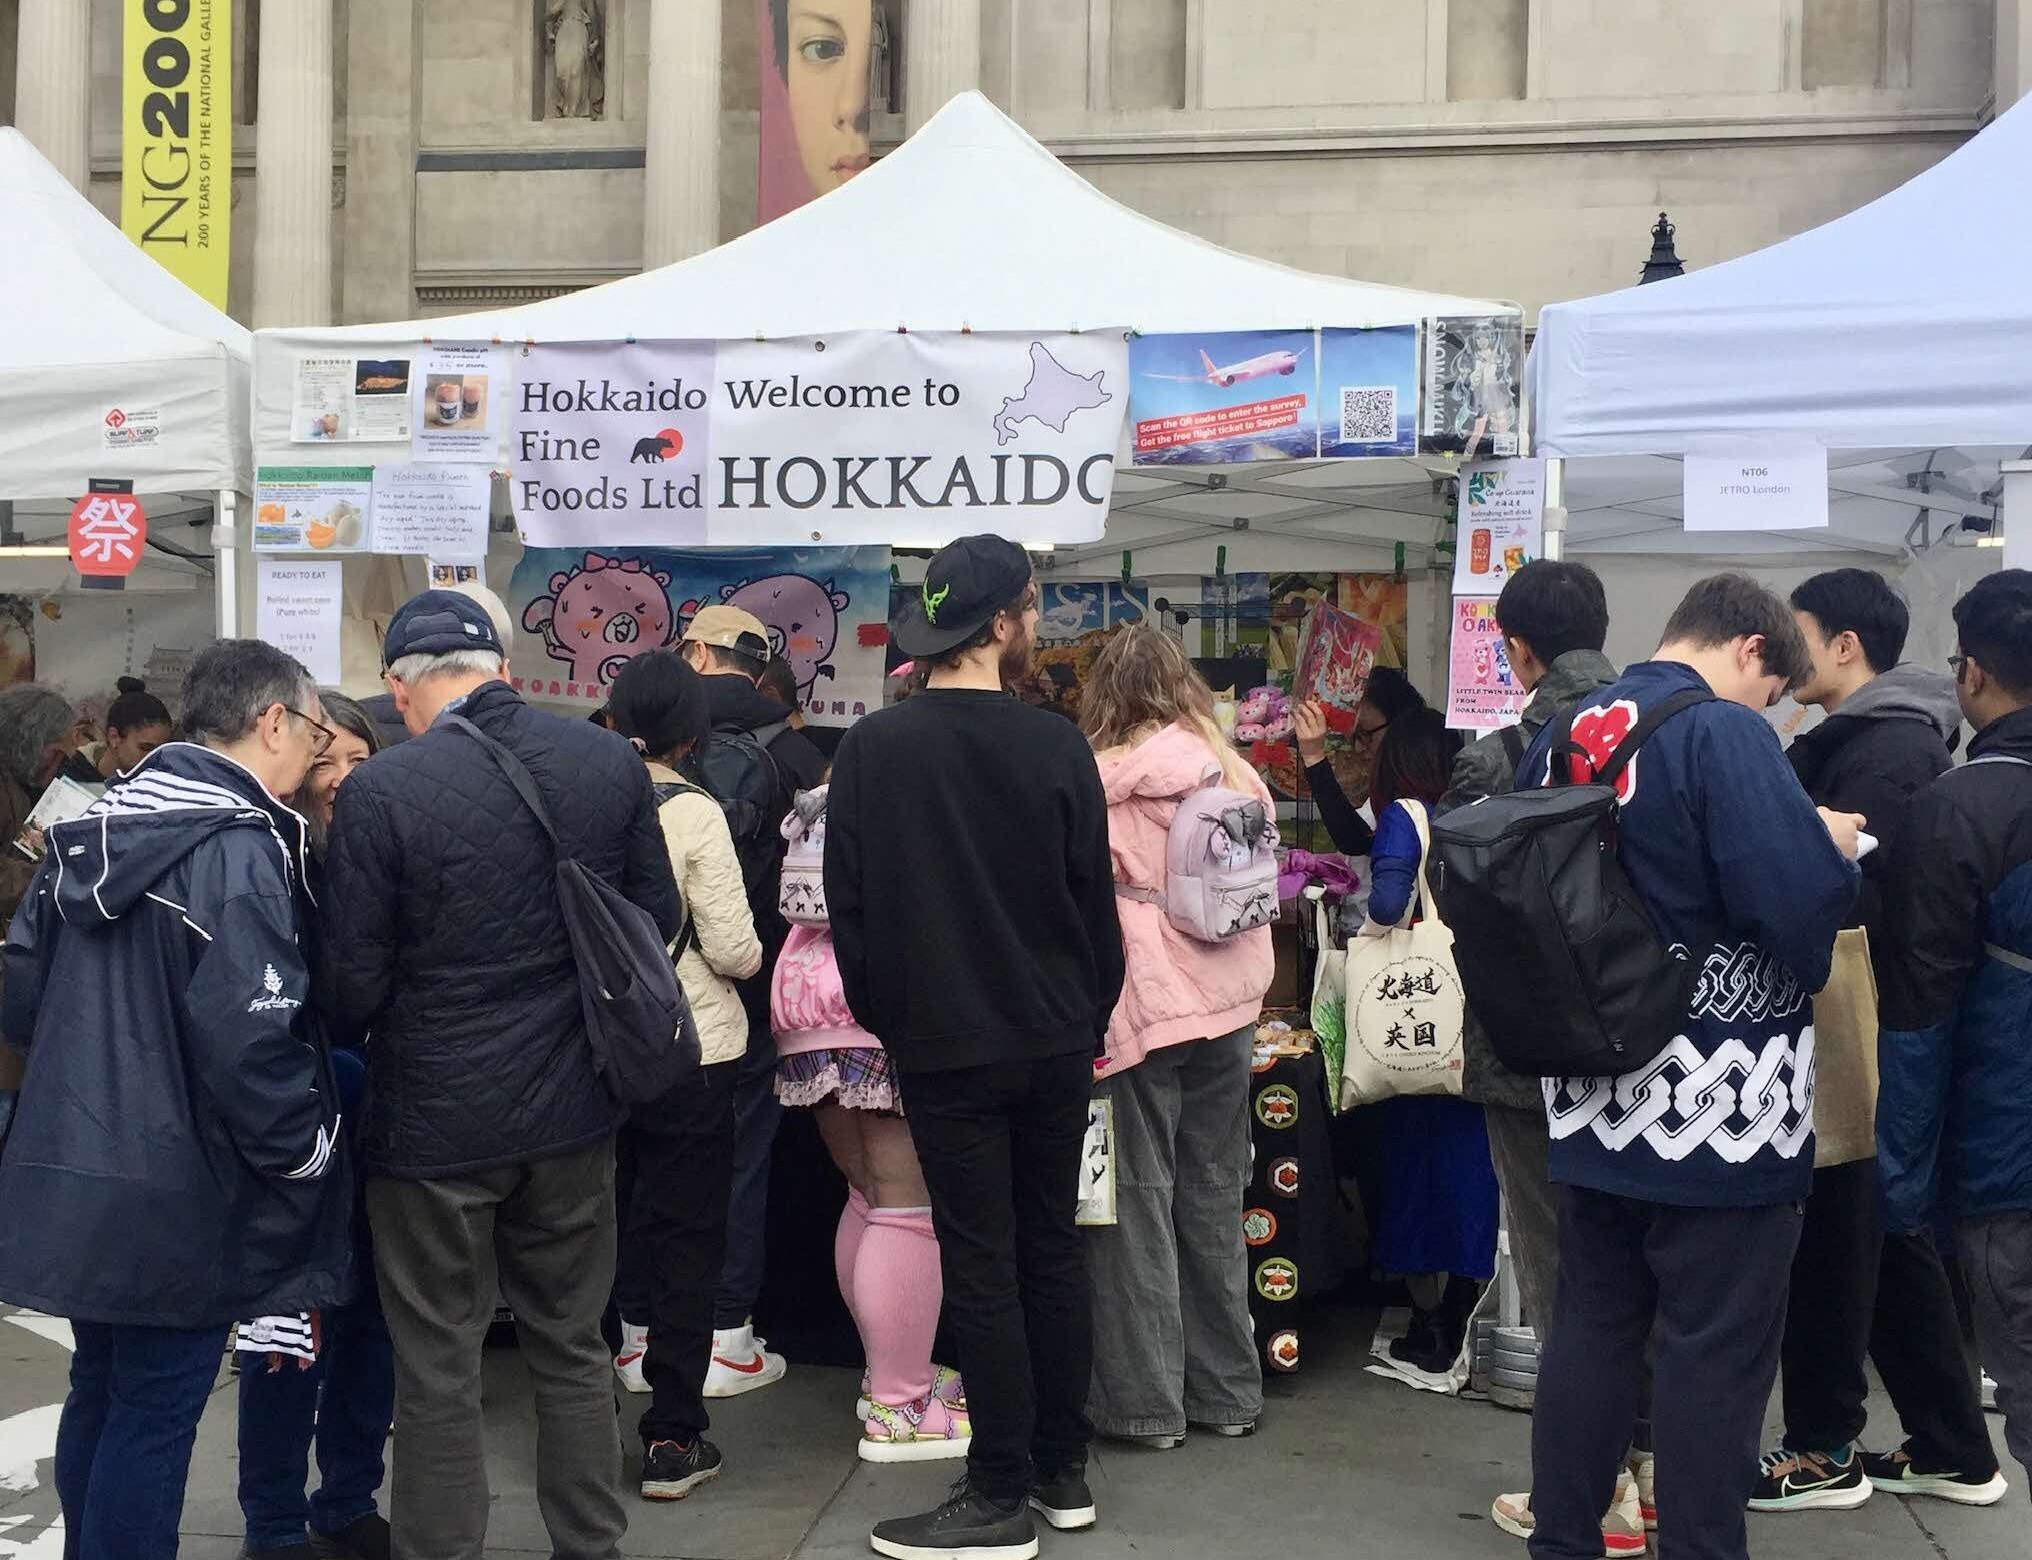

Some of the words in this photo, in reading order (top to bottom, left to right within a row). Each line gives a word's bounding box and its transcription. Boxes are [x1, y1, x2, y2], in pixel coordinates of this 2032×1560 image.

[200, 45, 211, 116] NATIONAL
[200, 122, 211, 147] THE
[200, 156, 211, 174] OF
[199, 177, 211, 219] YEARS
[198, 224, 209, 248] 200
[520, 379, 707, 412] Hokkaido
[724, 376, 911, 410] Welcome
[924, 378, 960, 407] to
[1139, 422, 1161, 434] Scan
[1163, 419, 1177, 429] the
[1179, 417, 1193, 427] QR
[1194, 415, 1216, 426] code
[1217, 412, 1227, 421] to
[1228, 408, 1252, 420] enter
[1253, 404, 1268, 414] the
[1140, 437, 1156, 447] Get
[1157, 434, 1172, 444] the
[1173, 431, 1191, 442] free
[1193, 427, 1216, 440] flight
[1217, 423, 1244, 435] ticket
[1245, 420, 1254, 429] to
[519, 430, 600, 461] Fine
[1741, 467, 1768, 477] NT06
[520, 475, 627, 511] Foods
[640, 474, 703, 509] Ltd
[1720, 485, 1750, 494] JETRO
[1753, 485, 1790, 494] London
[79, 497, 139, 562] 祭
[271, 571, 298, 579] READY
[300, 571, 310, 579] TO
[312, 571, 327, 579] EAT
[1376, 967, 1442, 1001] 北海道
[1384, 1021, 1436, 1051] 英国
